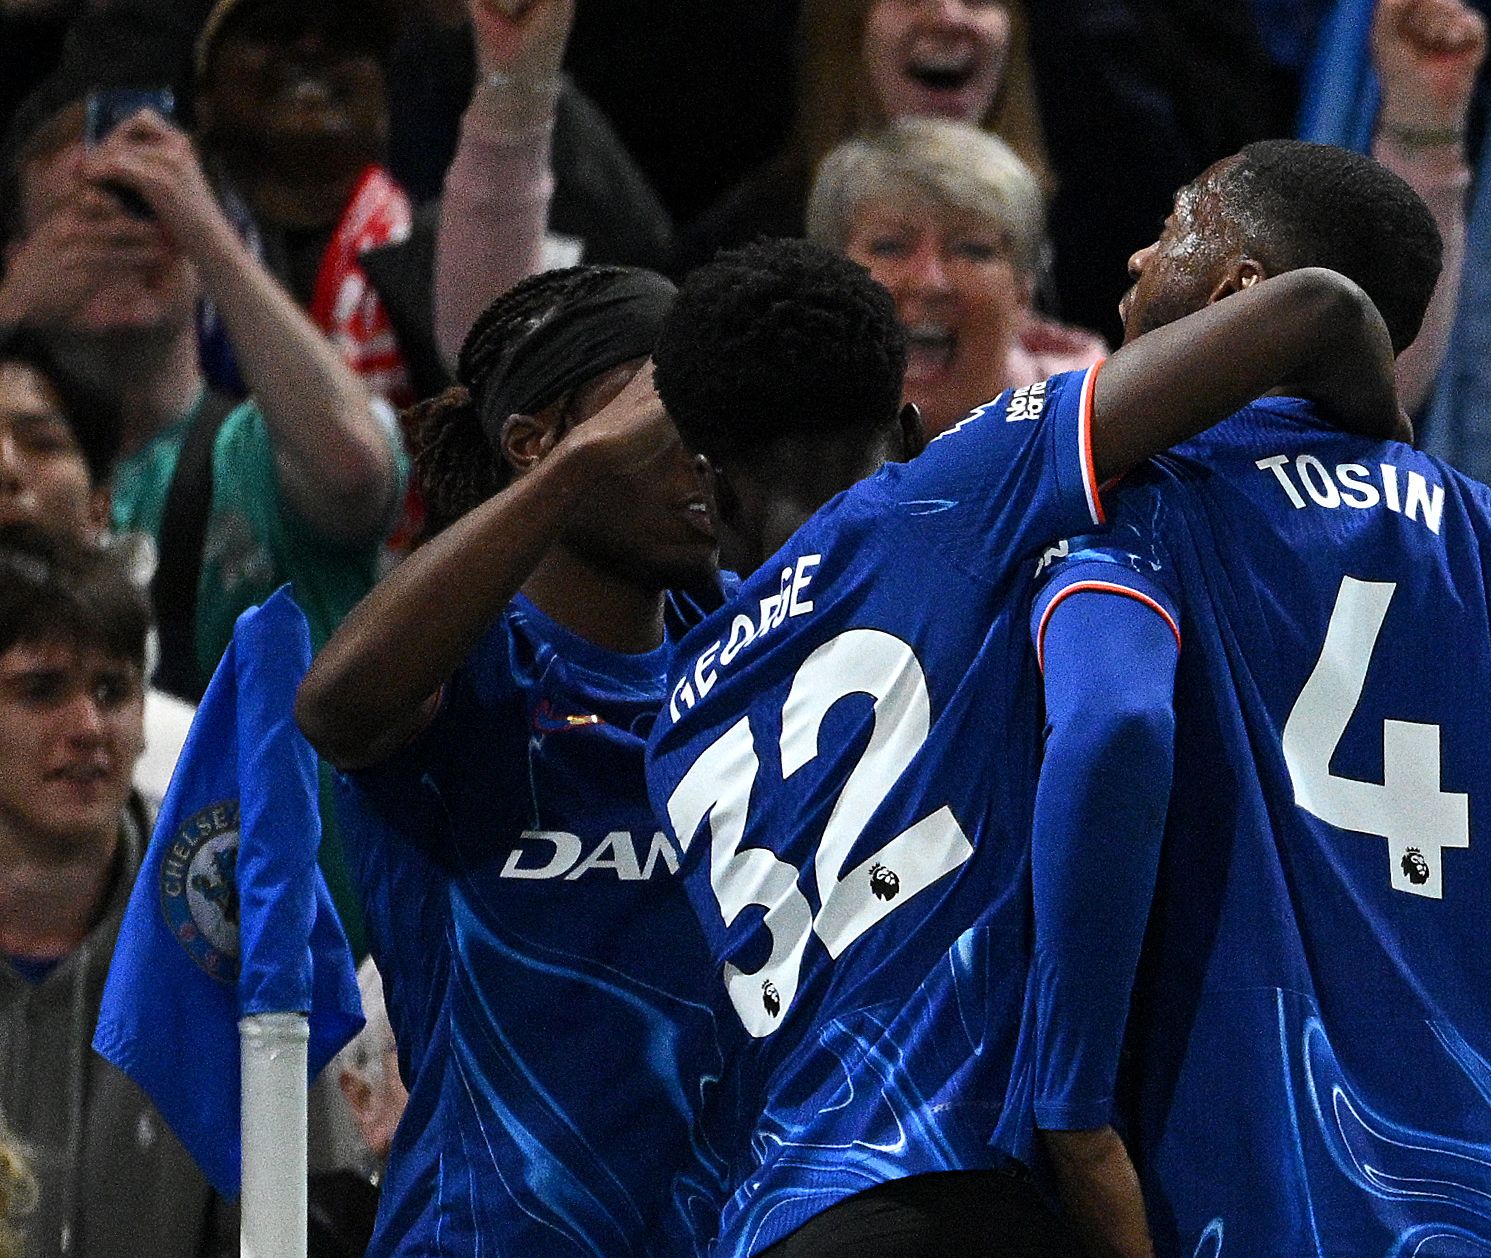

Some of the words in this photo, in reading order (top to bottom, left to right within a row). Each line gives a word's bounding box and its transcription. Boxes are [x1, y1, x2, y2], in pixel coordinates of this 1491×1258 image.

[1255, 454, 1445, 535] TOSIN
[667, 628, 974, 1037] 32
[1282, 575, 1469, 899] 4
[166, 805, 240, 897] CHELSE
